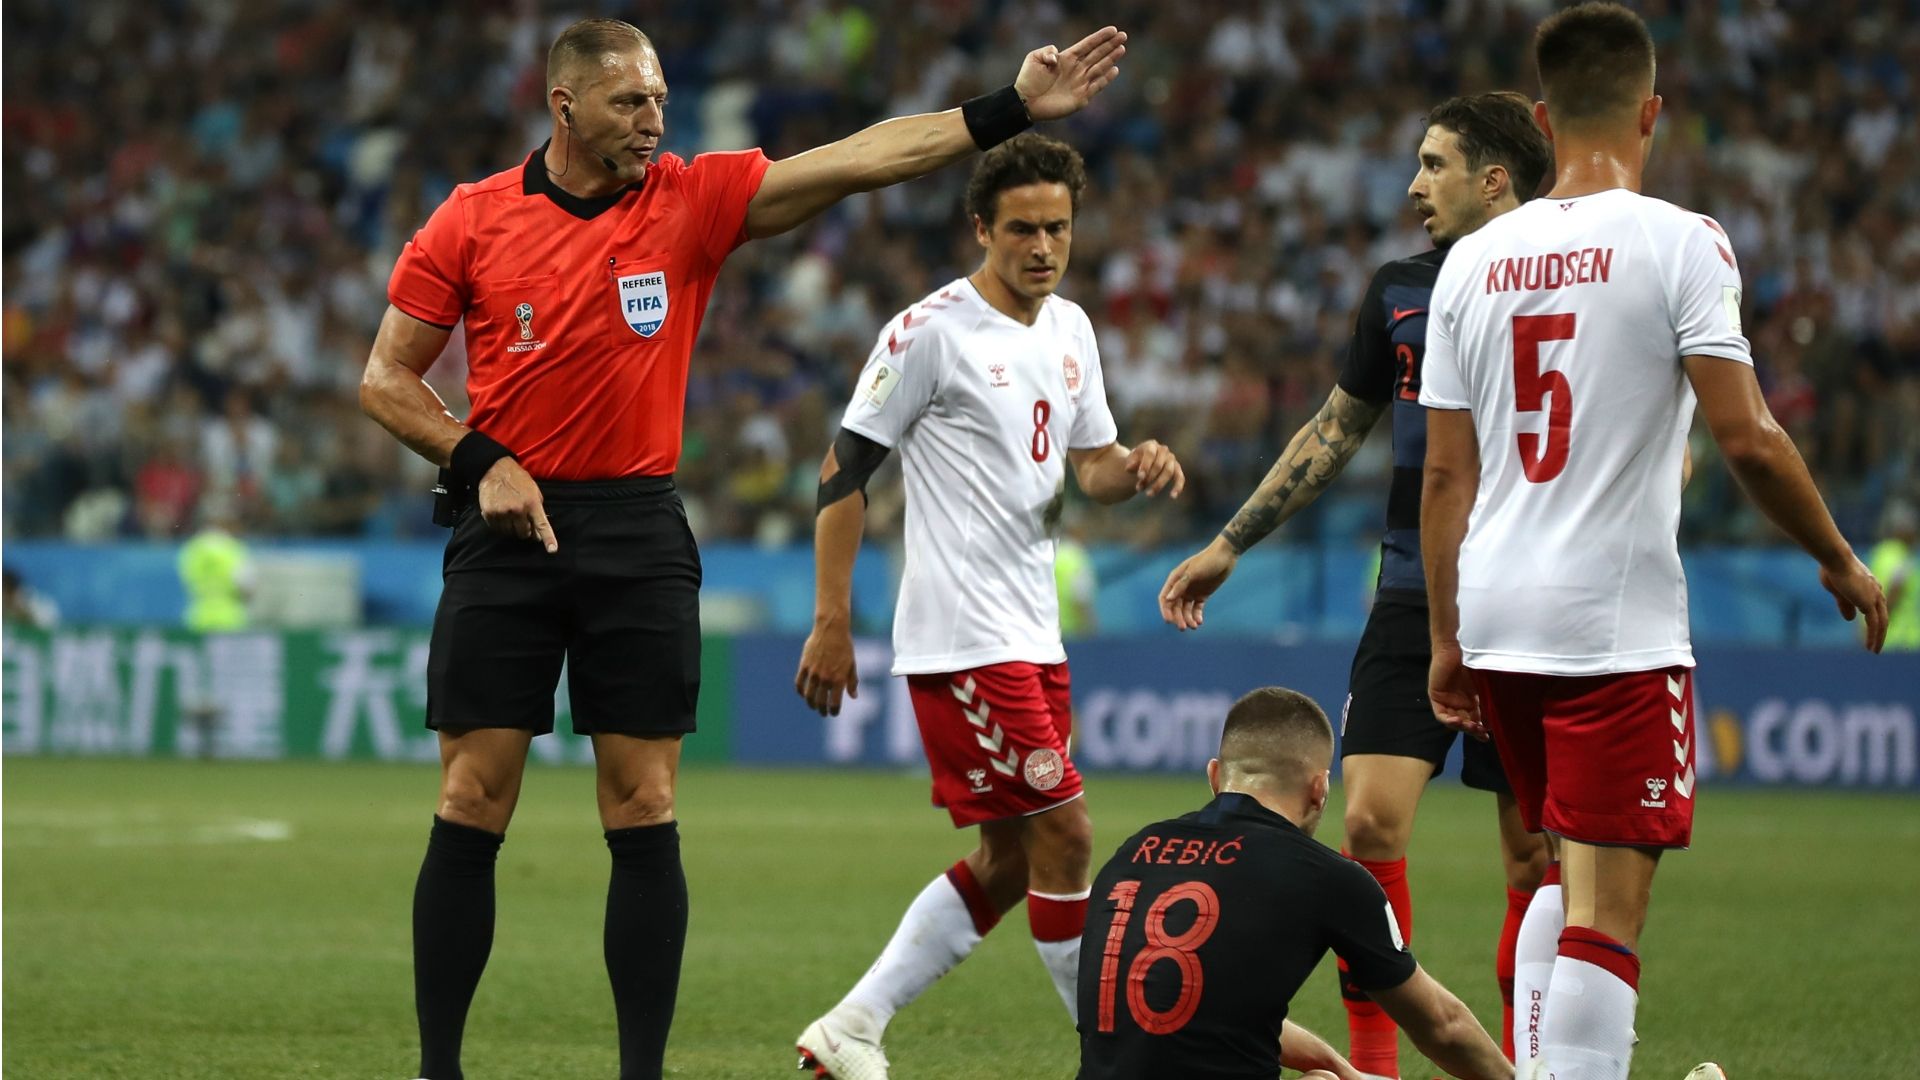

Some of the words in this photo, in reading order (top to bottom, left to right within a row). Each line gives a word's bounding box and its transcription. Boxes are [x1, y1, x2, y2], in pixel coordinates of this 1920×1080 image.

[622, 276, 662, 290] REFEREE
[1486, 248, 1614, 295] KNUDSEN
[627, 295, 662, 313] FIFA
[639, 323, 656, 332] 2018
[1512, 312, 1576, 484] 5
[1031, 399, 1051, 463] 8
[1131, 836, 1245, 865] REBIĆ
[1098, 880, 1221, 1036] 18
